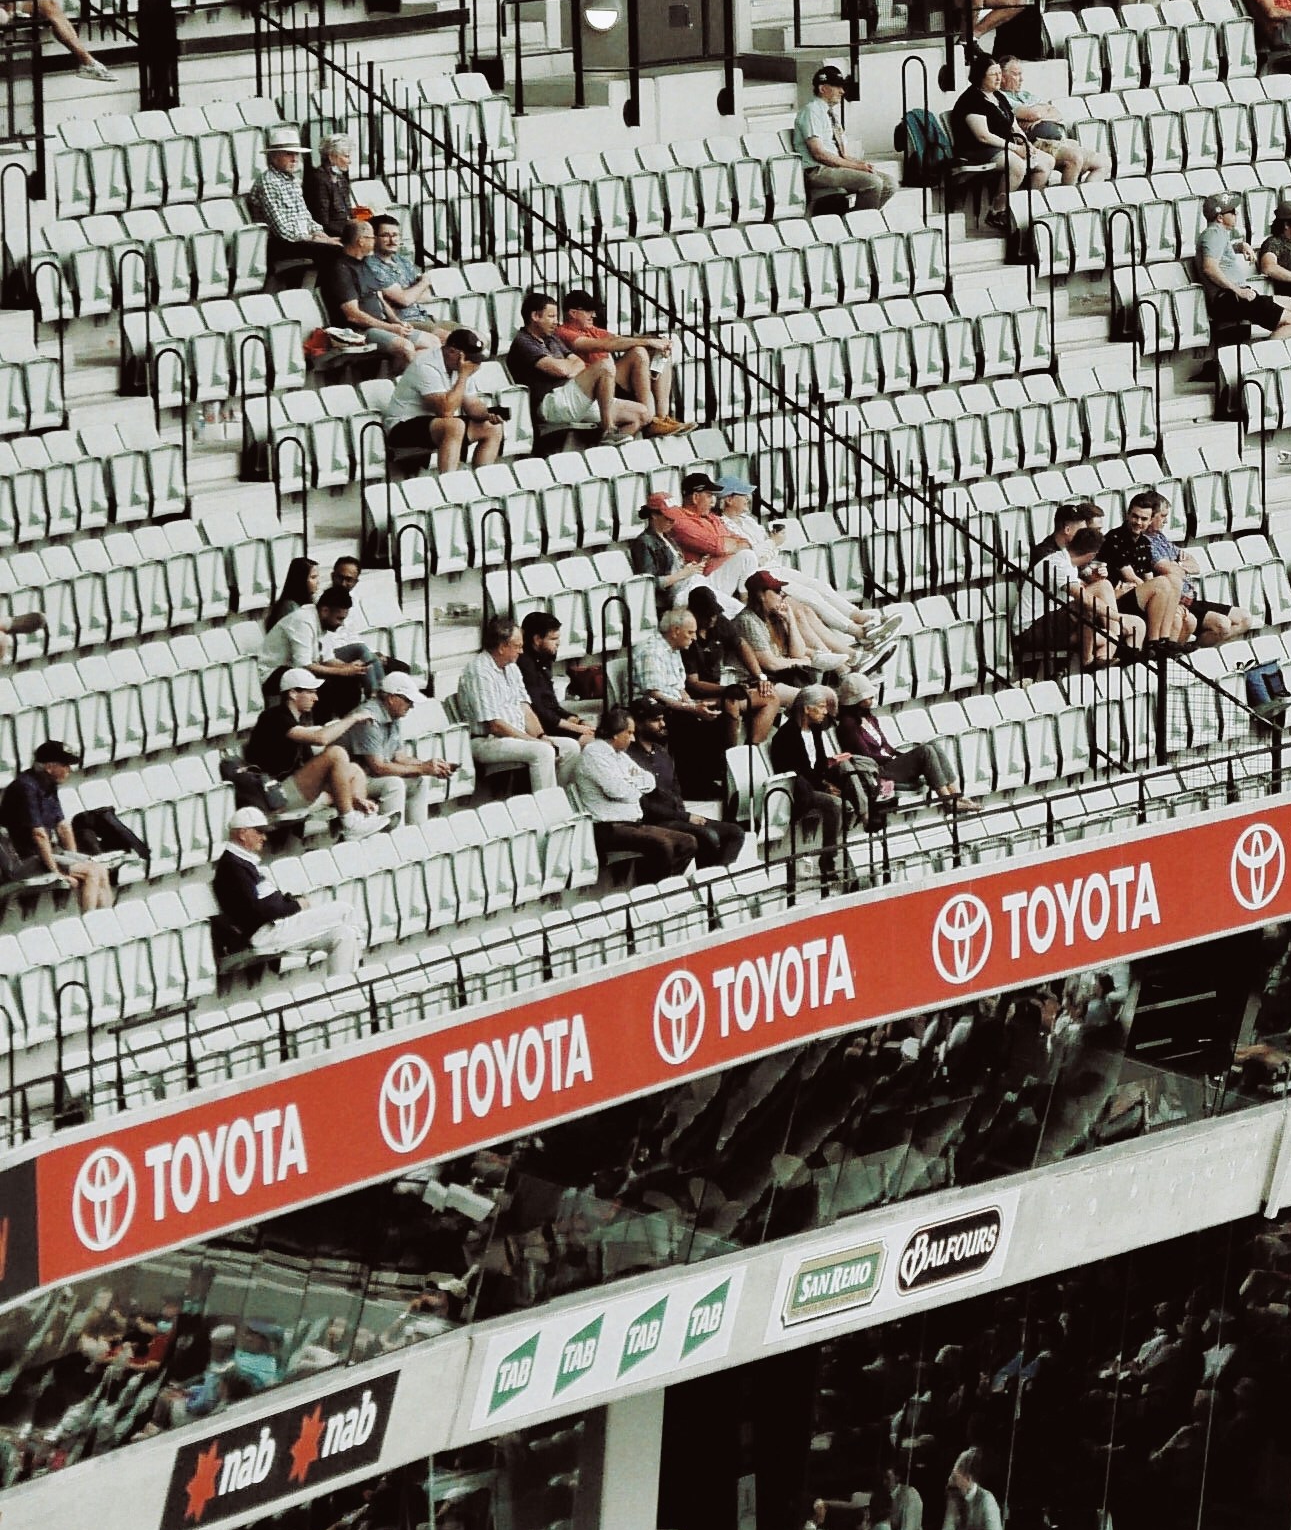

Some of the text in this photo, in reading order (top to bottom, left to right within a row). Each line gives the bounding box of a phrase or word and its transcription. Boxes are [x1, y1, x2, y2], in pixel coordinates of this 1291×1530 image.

[1002, 862, 1161, 959] TOYOTA
[712, 934, 856, 1037] TOYOTA
[443, 1014, 593, 1124] TOYOTA
[145, 1104, 308, 1221] TOYOTA
[798, 1261, 872, 1303] SAN REMO
[900, 1224, 998, 1287] BALFOURS
[626, 1321, 660, 1355] TAB
[690, 1302, 724, 1338] TAB
[498, 1357, 532, 1393] TAB
[563, 1338, 597, 1374] TAB
[321, 1390, 378, 1458] nab
[218, 1426, 276, 1496] nab
